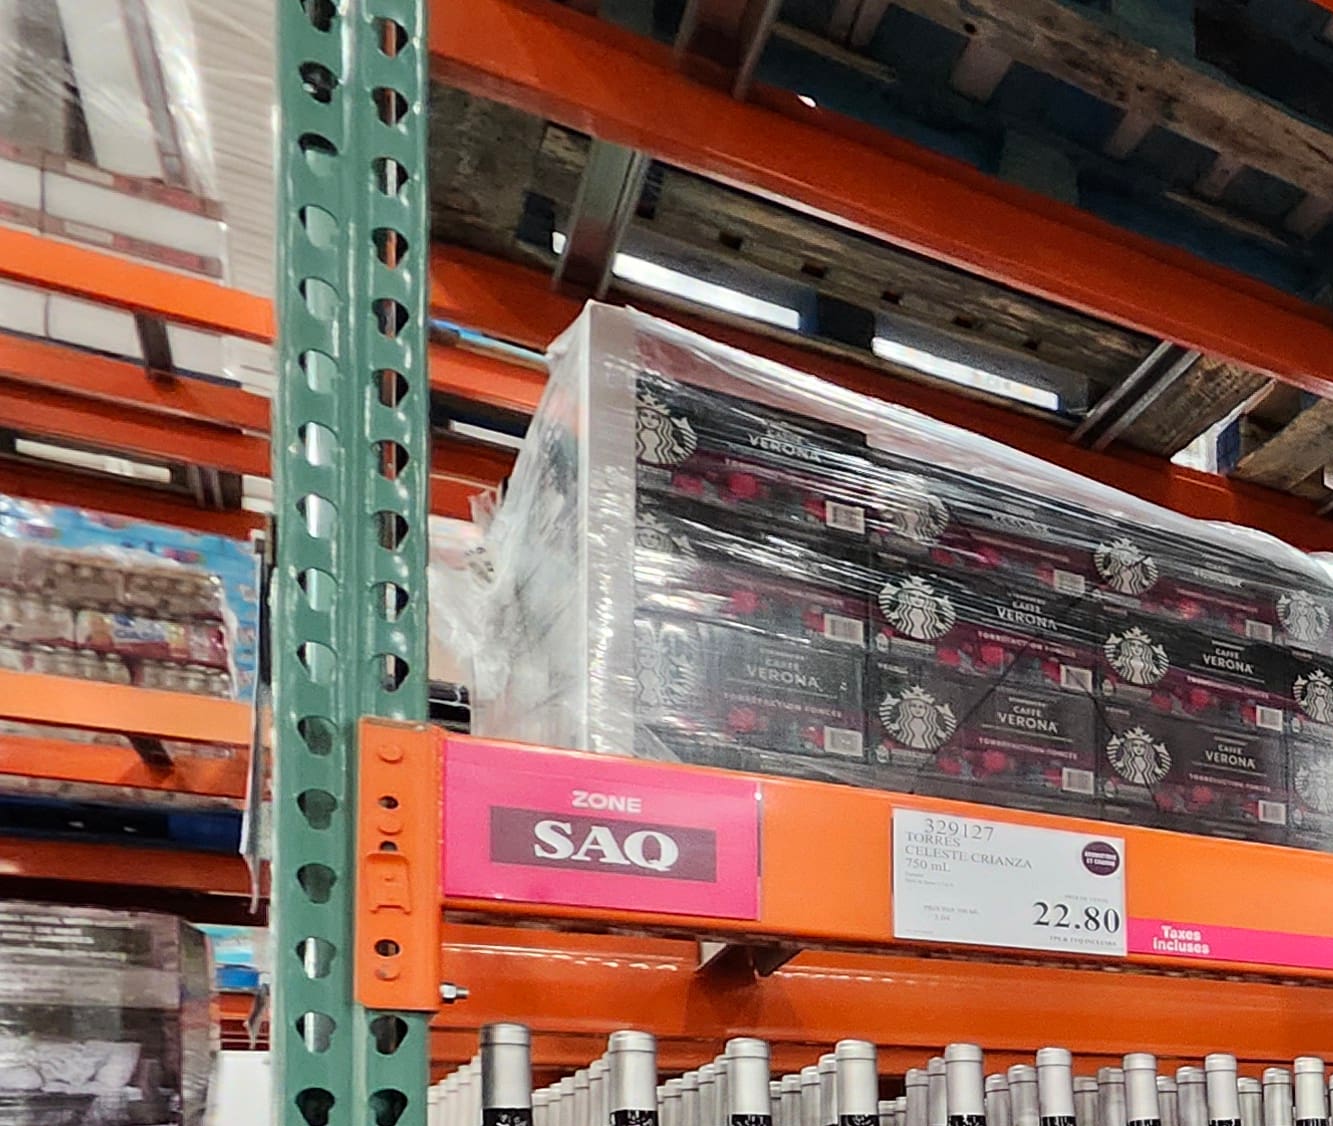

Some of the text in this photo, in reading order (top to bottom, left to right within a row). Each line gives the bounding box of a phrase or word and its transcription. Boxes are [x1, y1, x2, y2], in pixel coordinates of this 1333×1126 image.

[997, 606, 1059, 631] VERONA
[1202, 654, 1254, 675] VERONA
[747, 664, 822, 690] VERONA
[997, 711, 1058, 734] VERONA
[1204, 751, 1256, 770] VERONA
[572, 790, 642, 814] ZONE
[905, 831, 961, 848] TORRES
[924, 818, 994, 842] 329127
[534, 820, 679, 872] SAQ
[905, 844, 1033, 870] CELESTE CRIANZA
[905, 857, 951, 873] 750 mL
[1032, 901, 1120, 934] 22.80
[1161, 924, 1201, 942] Taxes
